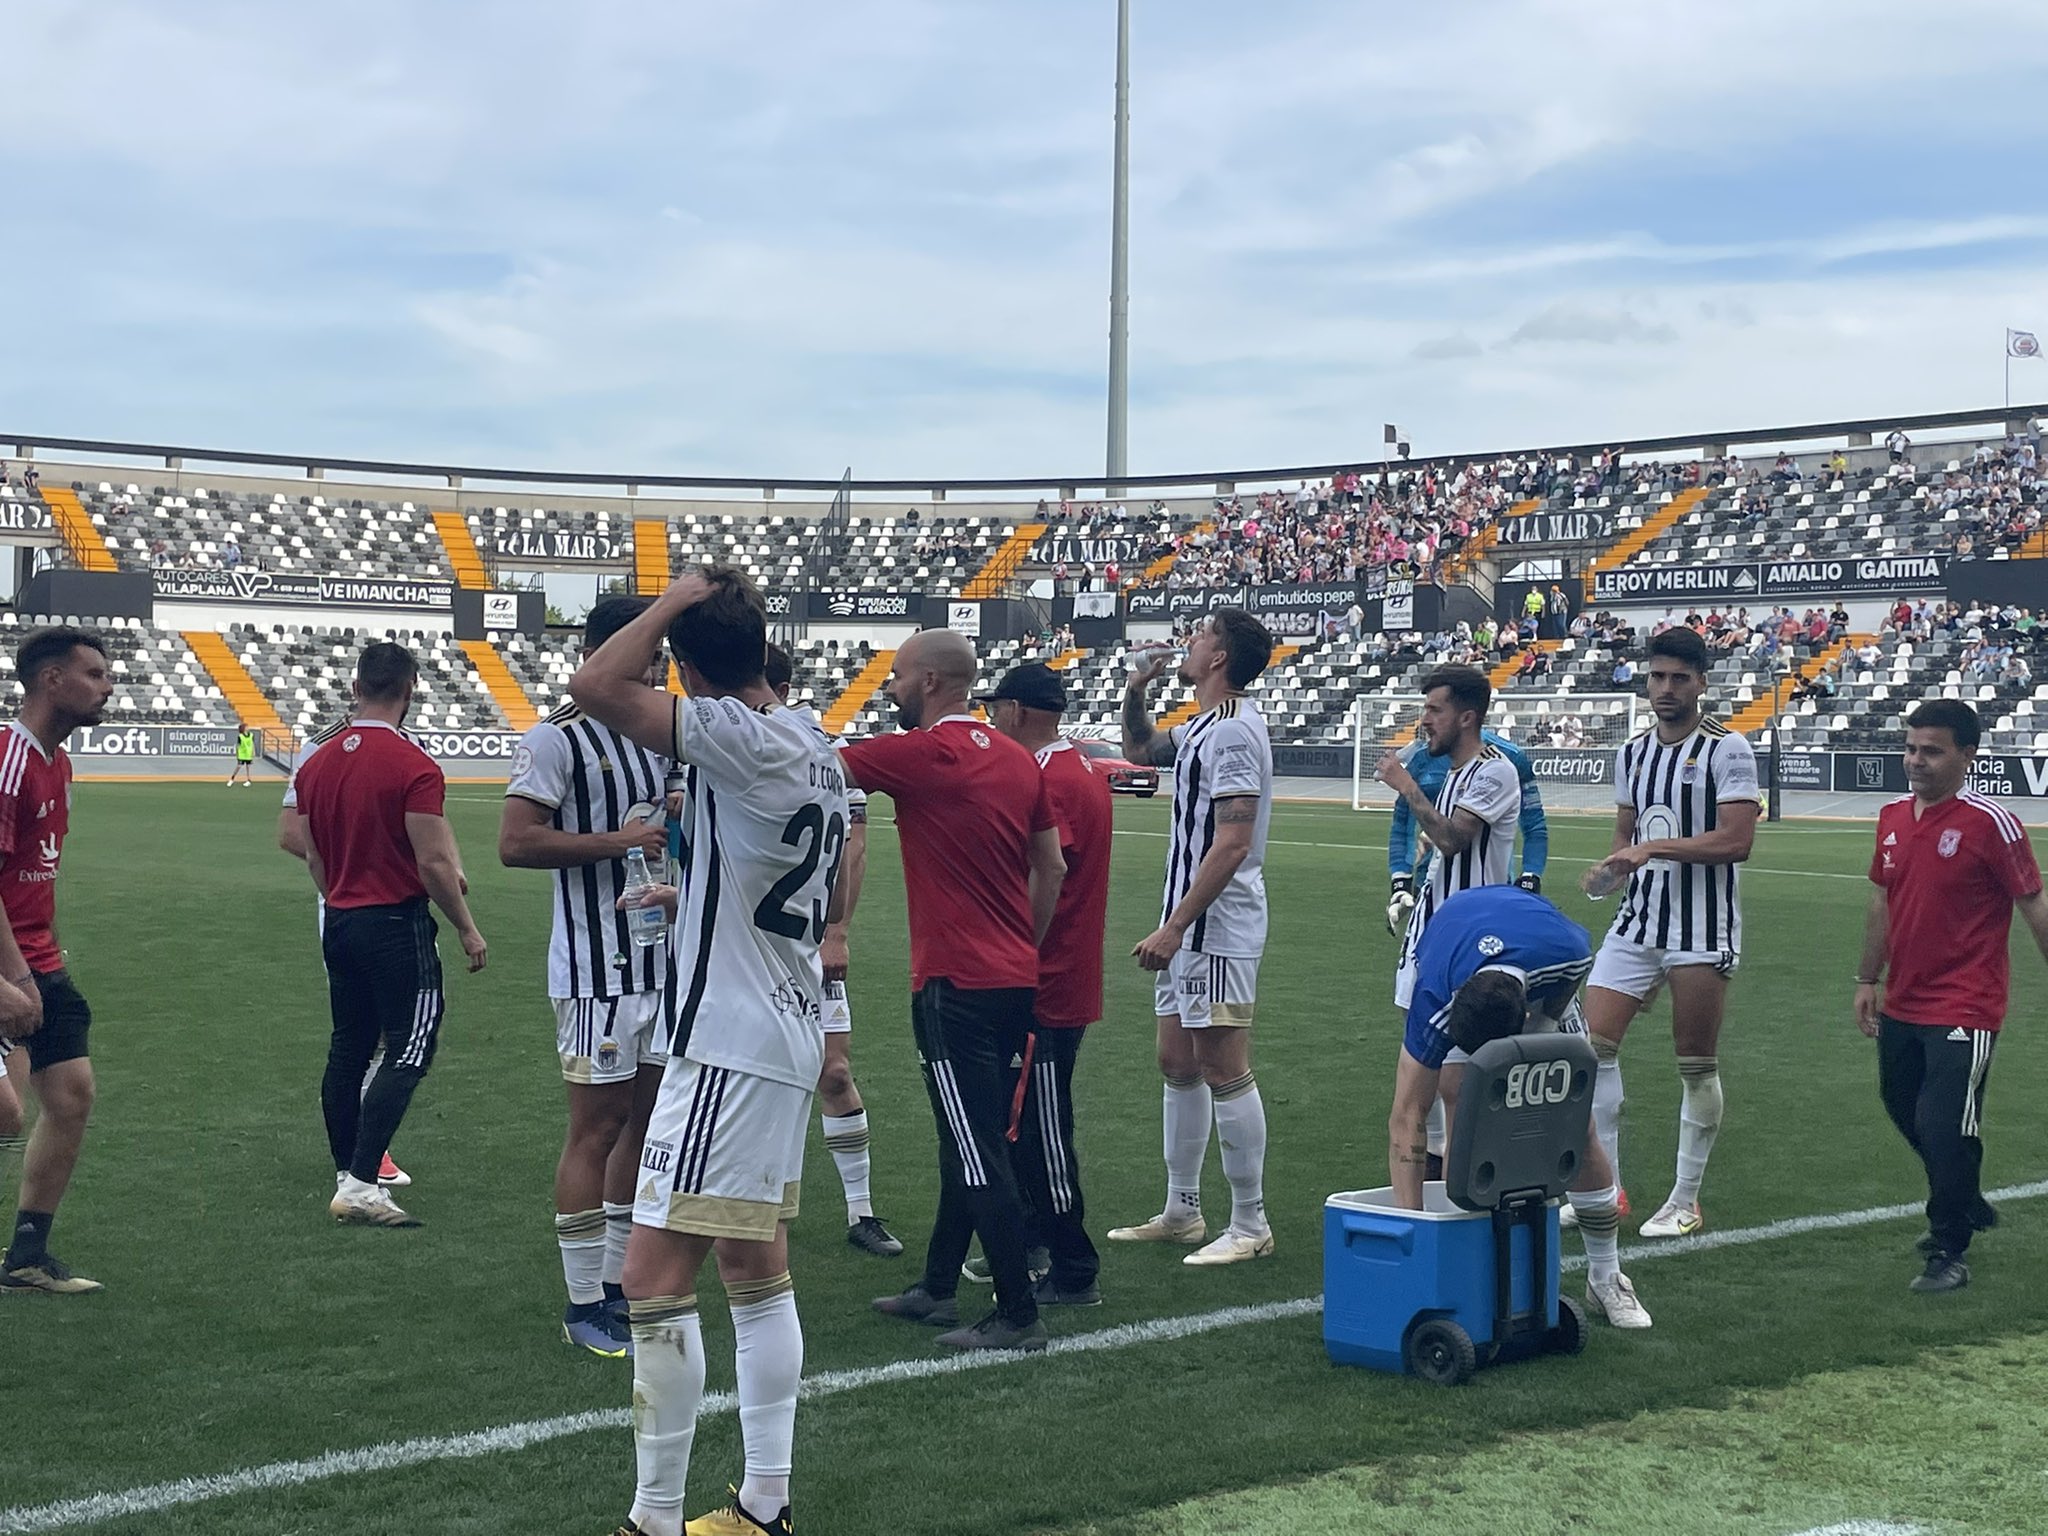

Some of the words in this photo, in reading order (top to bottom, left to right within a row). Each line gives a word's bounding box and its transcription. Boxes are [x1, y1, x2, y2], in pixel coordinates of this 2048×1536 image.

[1518, 516, 1541, 542] LA
[1548, 514, 1589, 541] MAR
[522, 533, 547, 556] LA
[554, 534, 596, 559] MAR
[153, 570, 229, 584] AUTOCARES
[1594, 572, 1653, 592] LEROY
[1656, 569, 1728, 590] MERLIN
[1767, 563, 1843, 583] AMALIO
[157, 582, 236, 596] VILAPLANA
[321, 582, 429, 602] VEIMANCHA
[1260, 590, 1322, 606] embutidos
[1323, 590, 1355, 606] pepe
[858, 595, 907, 606] DIPUTACIÓN
[1129, 591, 1165, 613] fmd
[1169, 590, 1204, 612] fmd
[1208, 588, 1243, 611] fmd
[868, 606, 906, 615] BADAJOZ
[80, 726, 159, 755] Loft.
[169, 730, 225, 745] sinergias
[169, 743, 237, 754] inmobiliari
[1532, 752, 1605, 783] catering
[1967, 756, 2005, 774] ncia
[1964, 775, 2013, 795] iliaria
[753, 802, 844, 945] 23
[1505, 1059, 1572, 1108] CDB
